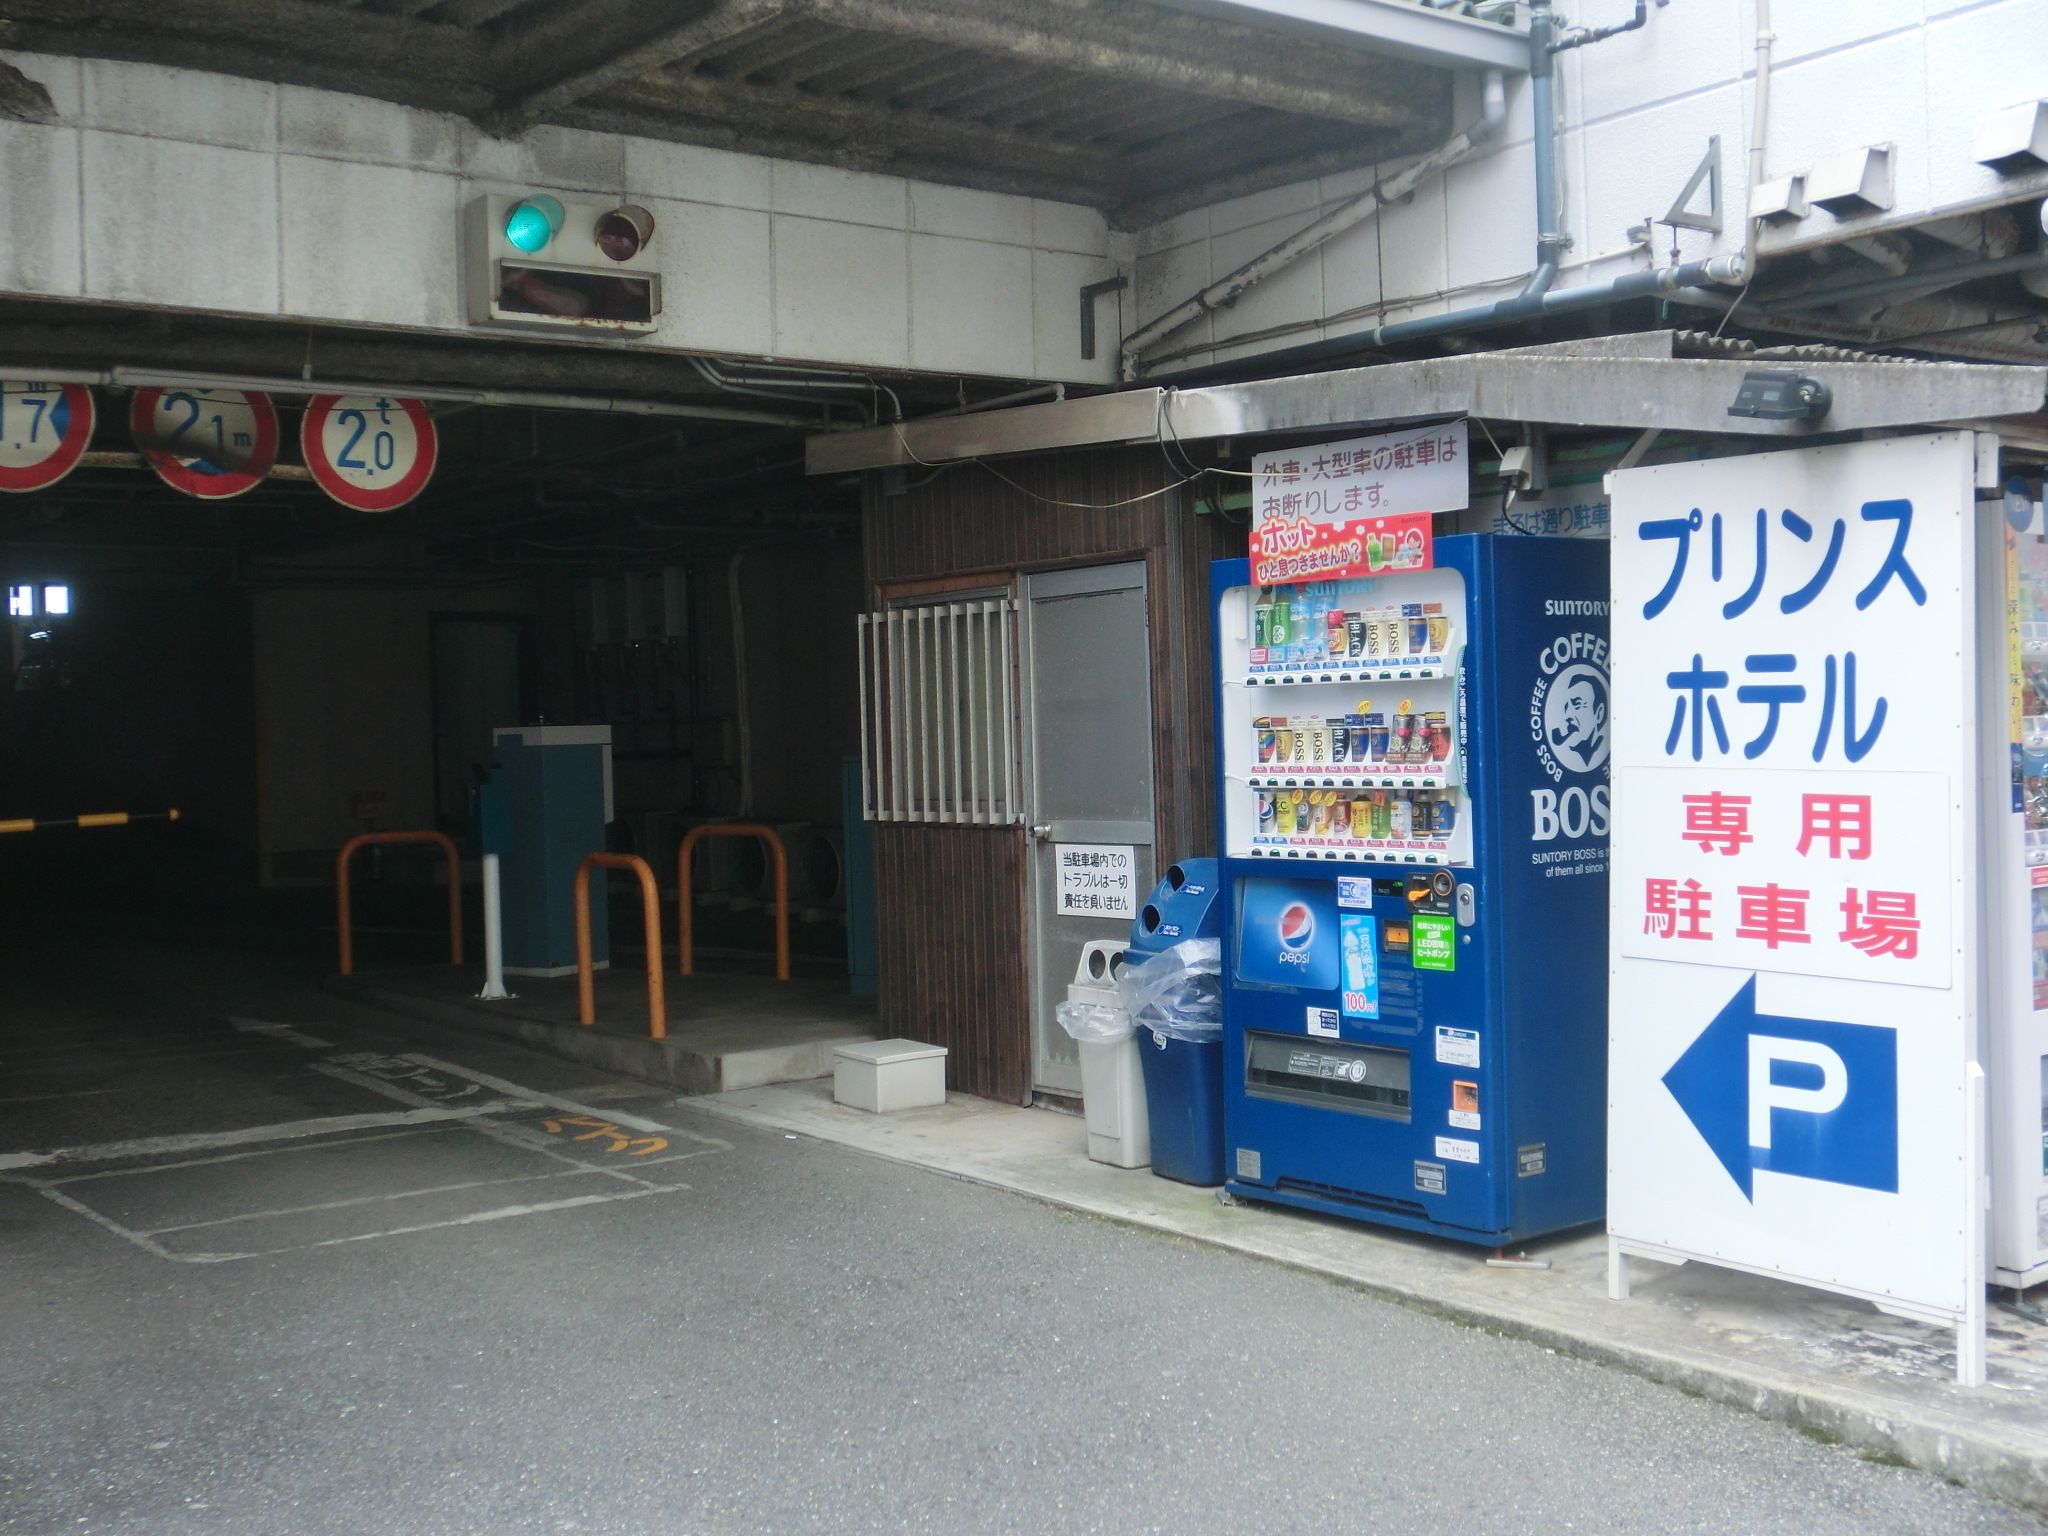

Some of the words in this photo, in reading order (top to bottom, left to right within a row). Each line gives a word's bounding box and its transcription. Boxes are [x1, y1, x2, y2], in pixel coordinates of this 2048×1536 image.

[337, 408, 394, 476] 2.0
[1262, 435, 1458, 488] 外車・大型車の駐車は
[1262, 481, 1389, 521] お断りします。
[1492, 502, 1610, 536] まるは通り駐車
[1262, 521, 1314, 553] ホット
[1258, 541, 1361, 580] ひと息つきませんか？
[1638, 498, 1928, 621] プリンス
[1545, 599, 1610, 616] SUNTORY
[1369, 624, 1380, 656] BOSS
[1388, 622, 1400, 655] BOSS
[1530, 677, 1548, 742] COFFEE
[1665, 650, 1889, 764] ホテル
[1294, 732, 1305, 761] BOSS
[1313, 731, 1324, 761] BOSS
[1537, 745, 1563, 783] BOSS
[1530, 784, 1611, 841] BOS
[1682, 791, 1872, 860] 専用
[1063, 852, 1127, 868] 当駐車場内での
[1532, 850, 1573, 865] SUNTORY
[1574, 848, 1597, 861] BOSS
[1546, 866, 1553, 878] of
[1555, 865, 1574, 877] them
[1575, 863, 1584, 875] all
[1585, 861, 1604, 874] since
[1064, 872, 1128, 889] トラブルは一切
[1064, 893, 1129, 911] 責任を負いません
[1643, 878, 1921, 960] 駐車場
[1279, 950, 1311, 966] pepsi
[1747, 1033, 1849, 1150] P
